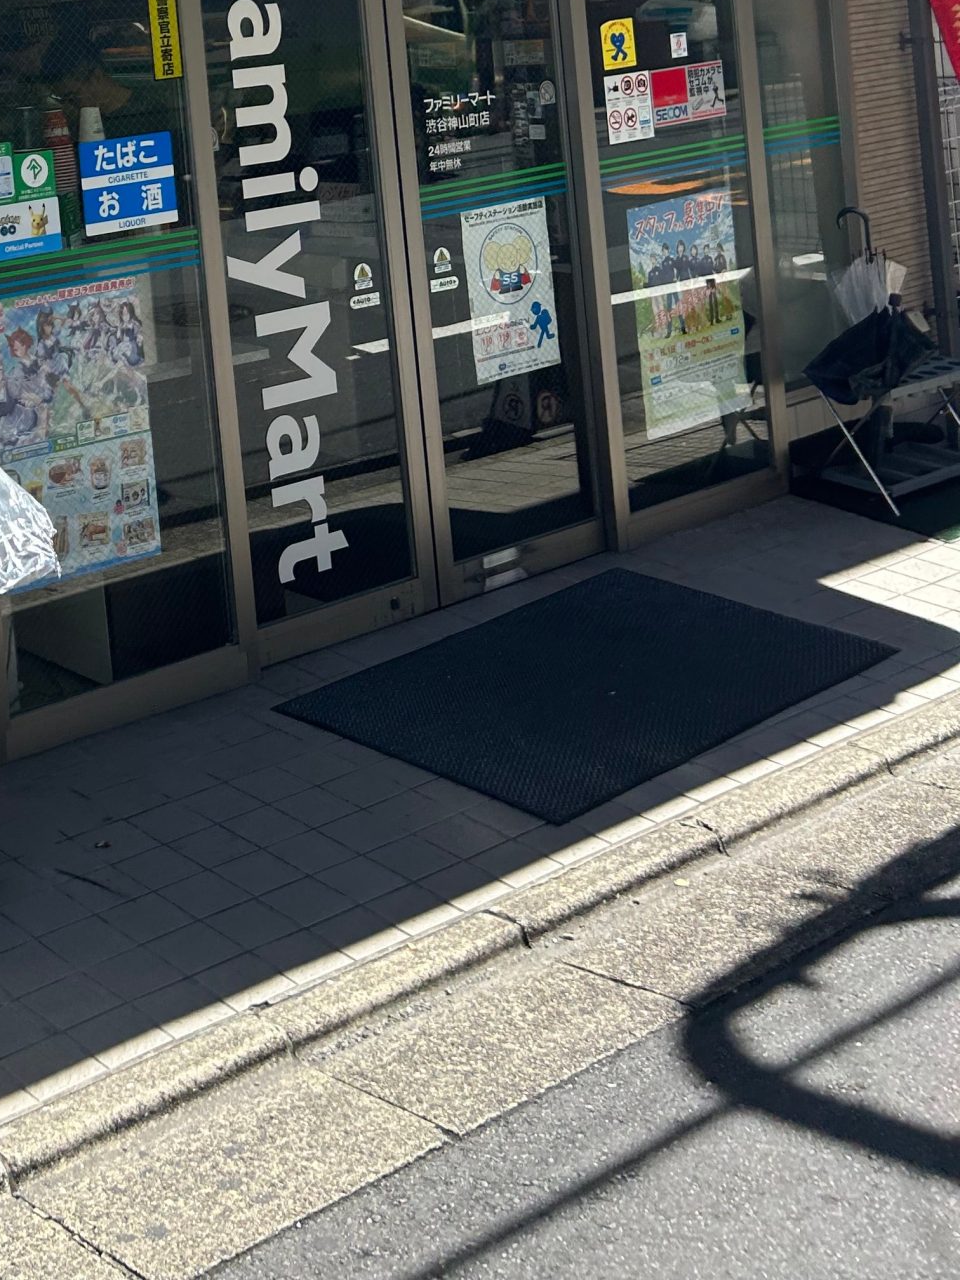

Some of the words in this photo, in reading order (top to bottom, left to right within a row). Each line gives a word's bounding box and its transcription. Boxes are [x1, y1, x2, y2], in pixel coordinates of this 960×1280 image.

[423, 90, 496, 113] ファミリーマート
[656, 105, 688, 121] SECOM
[425, 111, 490, 133] 渋谷神山町店
[93, 140, 158, 171] たばこ
[428, 140, 471, 157] 24時間営業
[429, 158, 461, 172] 年中無休
[502, 272, 519, 285] SS
